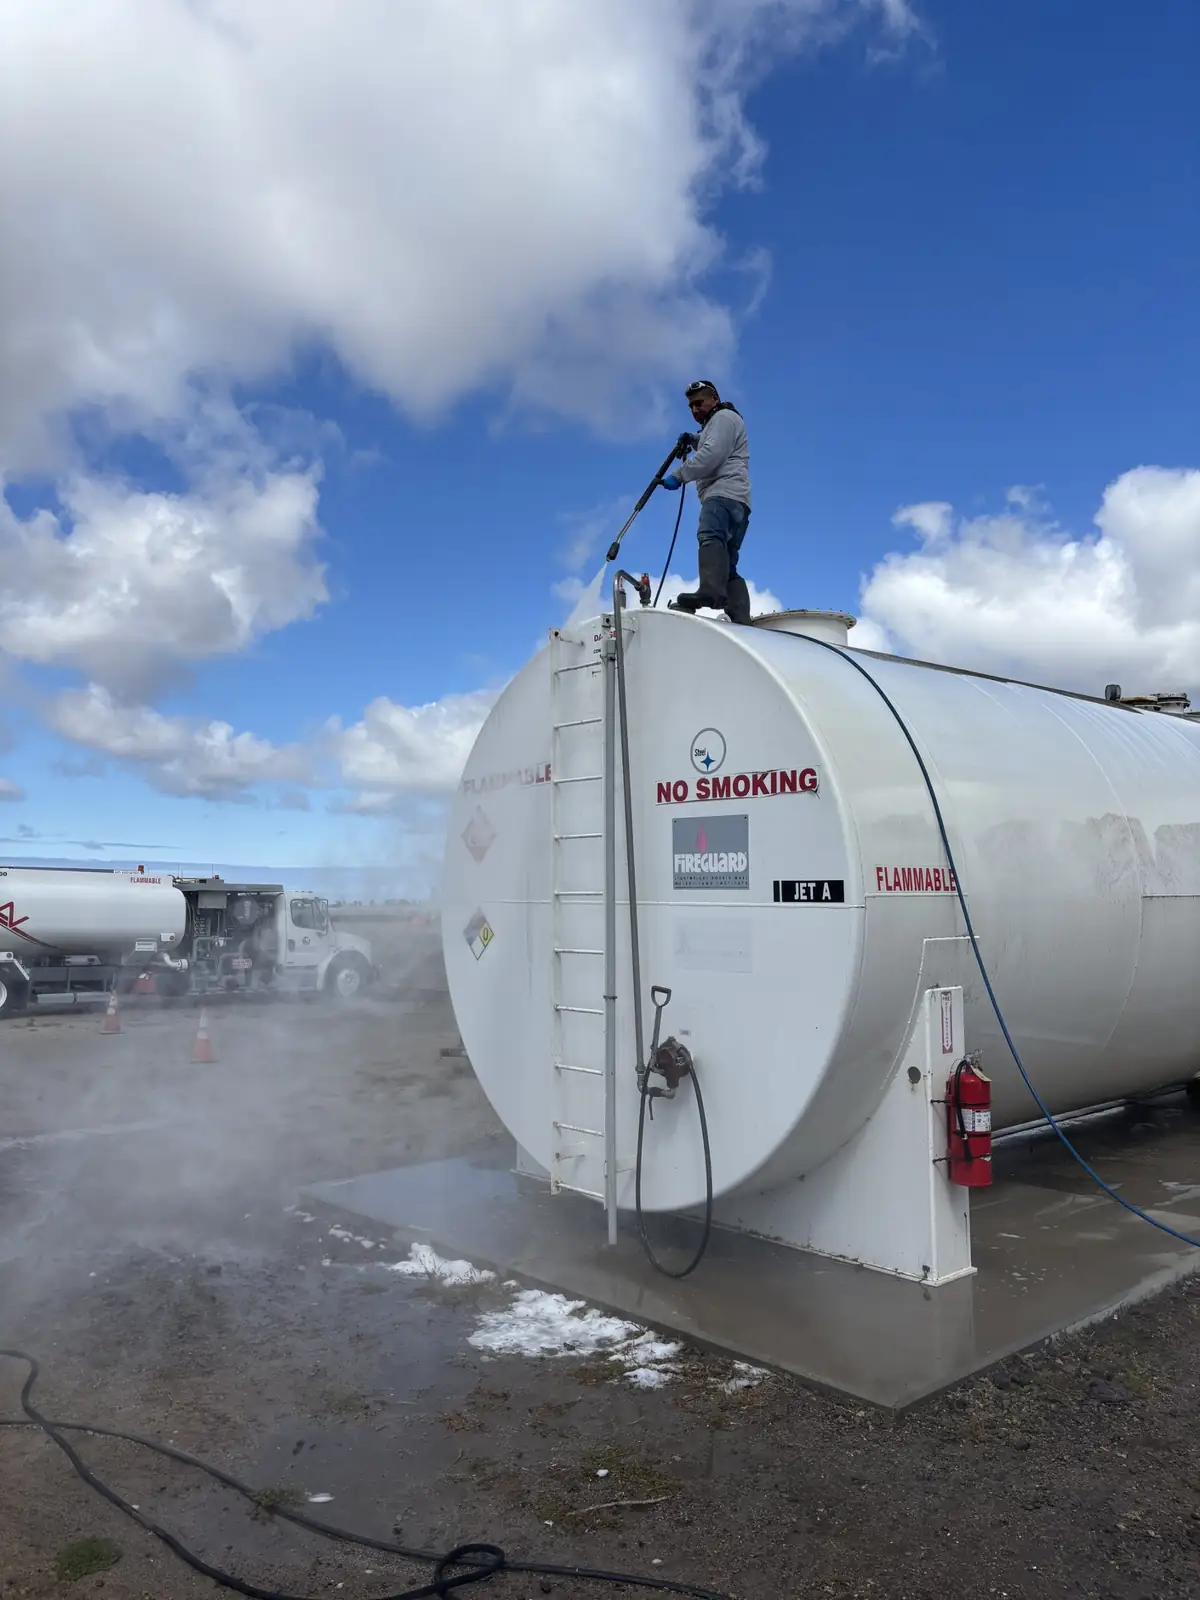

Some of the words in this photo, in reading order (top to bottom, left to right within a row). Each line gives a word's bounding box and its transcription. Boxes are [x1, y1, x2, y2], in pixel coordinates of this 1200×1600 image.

[694, 747, 707, 757] Steel
[463, 763, 551, 795] FLAMABLE
[657, 780, 689, 803] NO
[696, 767, 818, 800] SMOKING
[130, 876, 161, 885] FLAMMABLE
[876, 866, 957, 892] FLAMMABLE
[794, 882, 816, 900] JET
[822, 882, 832, 900] A
